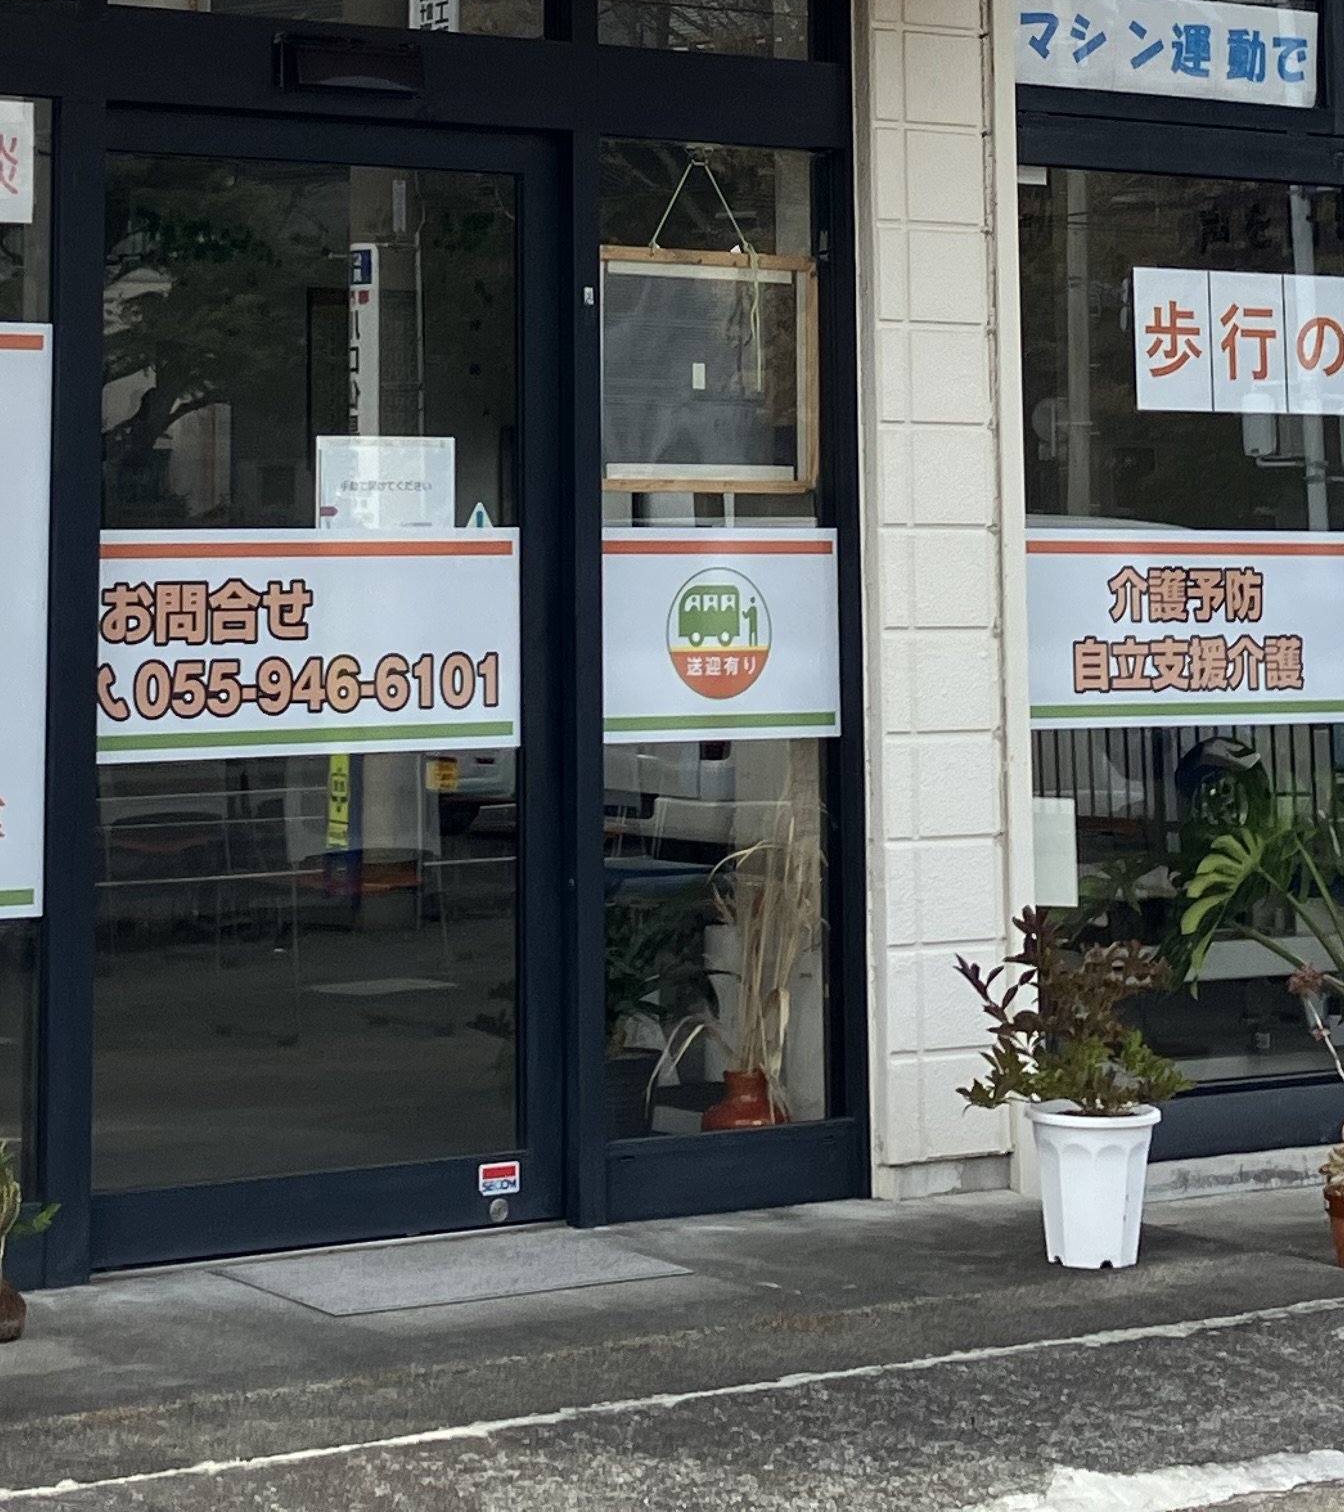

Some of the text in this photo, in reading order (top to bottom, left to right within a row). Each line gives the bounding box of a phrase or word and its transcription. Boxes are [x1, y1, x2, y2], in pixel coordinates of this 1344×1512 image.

[1018, 12, 1308, 84] マシン運動で
[101, 578, 313, 646] お問合せ
[1107, 565, 1263, 623] 介護予防
[134, 652, 500, 720] 055-946-6101
[686, 655, 756, 677] 送迎有り
[1073, 634, 1304, 693] 自立支援介護
